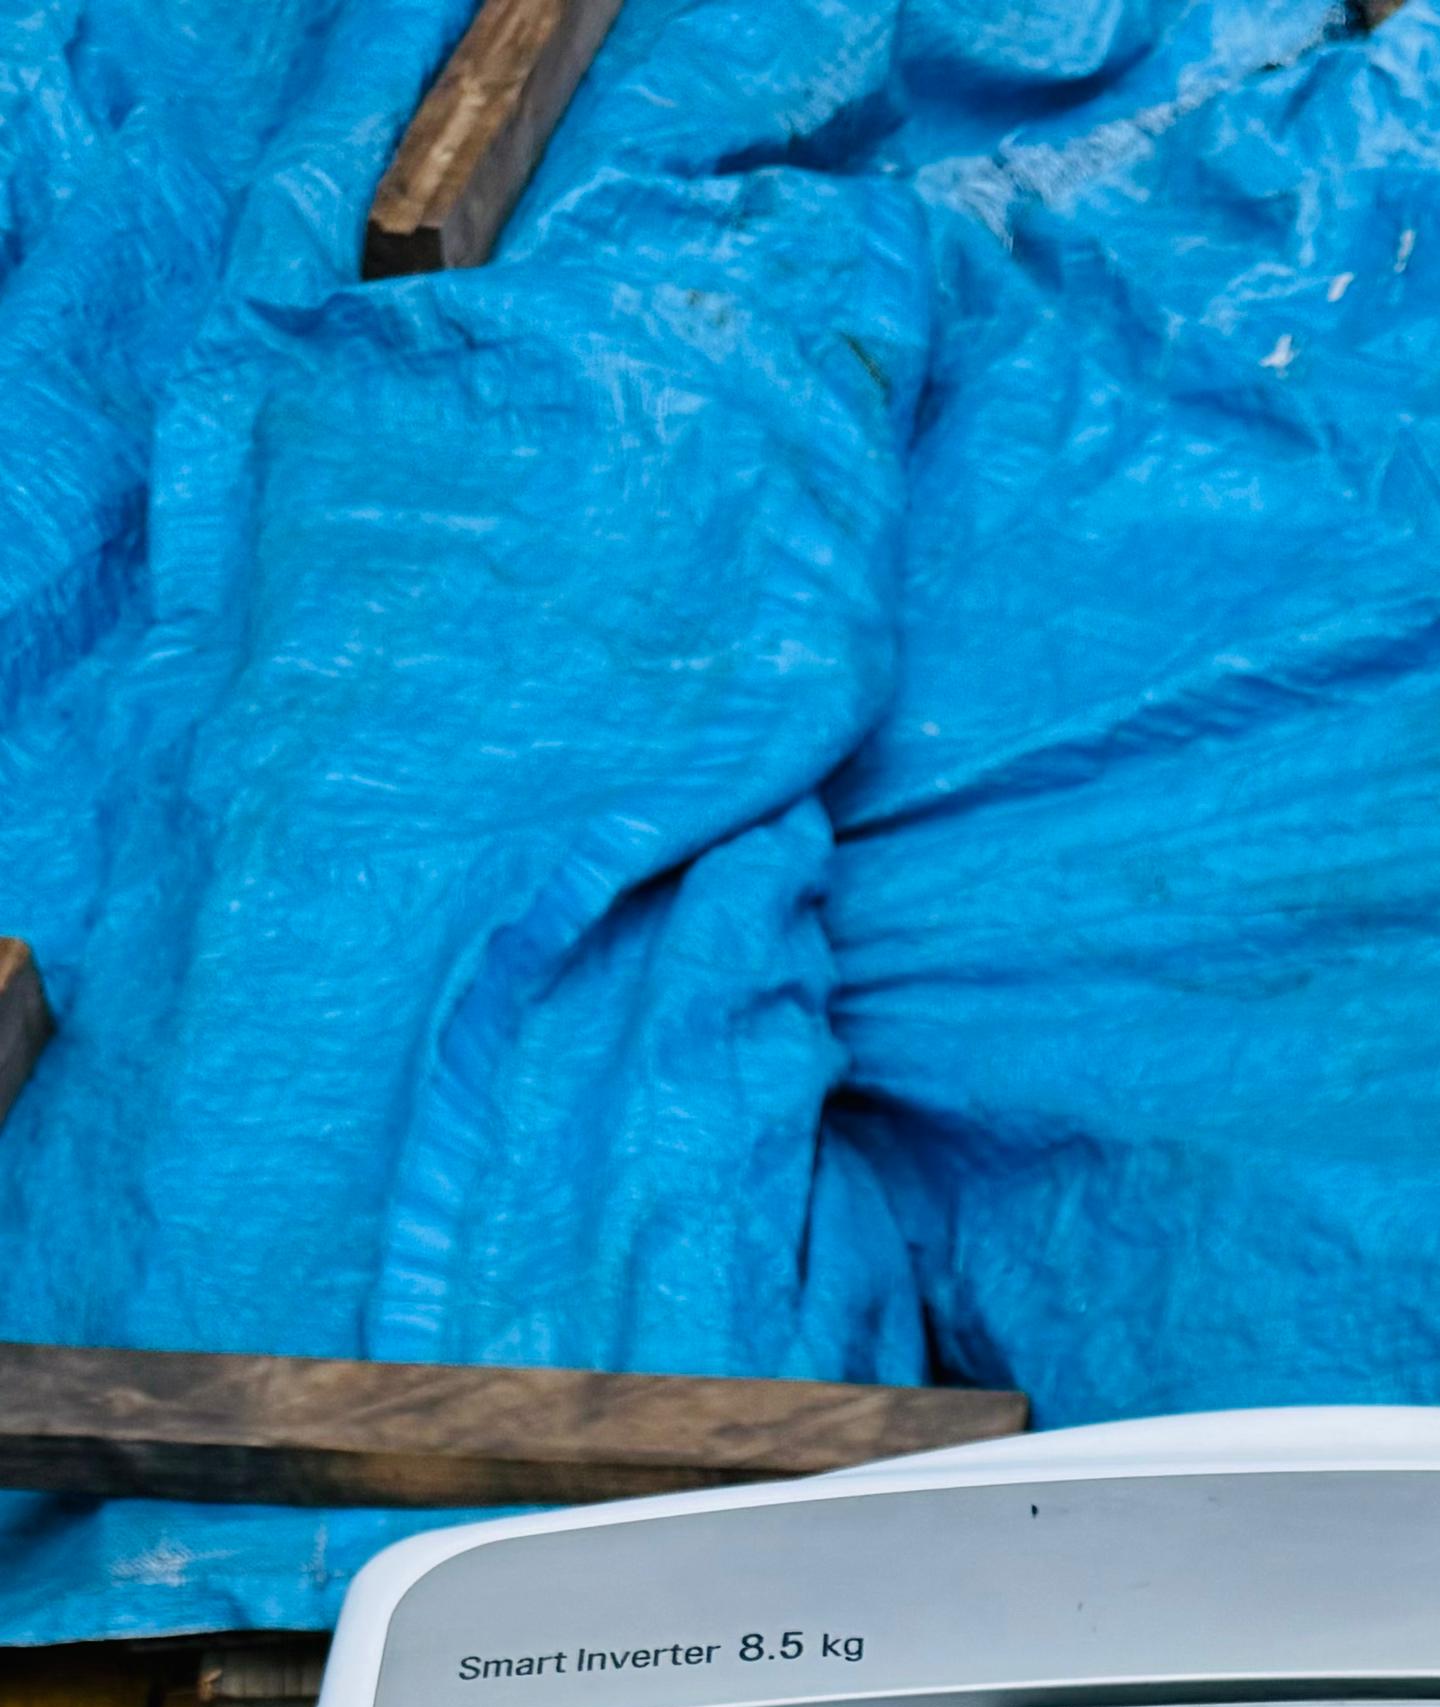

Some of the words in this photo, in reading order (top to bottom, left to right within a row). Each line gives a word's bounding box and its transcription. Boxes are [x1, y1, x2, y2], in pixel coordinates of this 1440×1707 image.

[458, 1651, 568, 1681] Smart
[577, 1643, 722, 1672] Inverter
[738, 1631, 804, 1662] 8.5
[822, 1633, 864, 1662] kg
